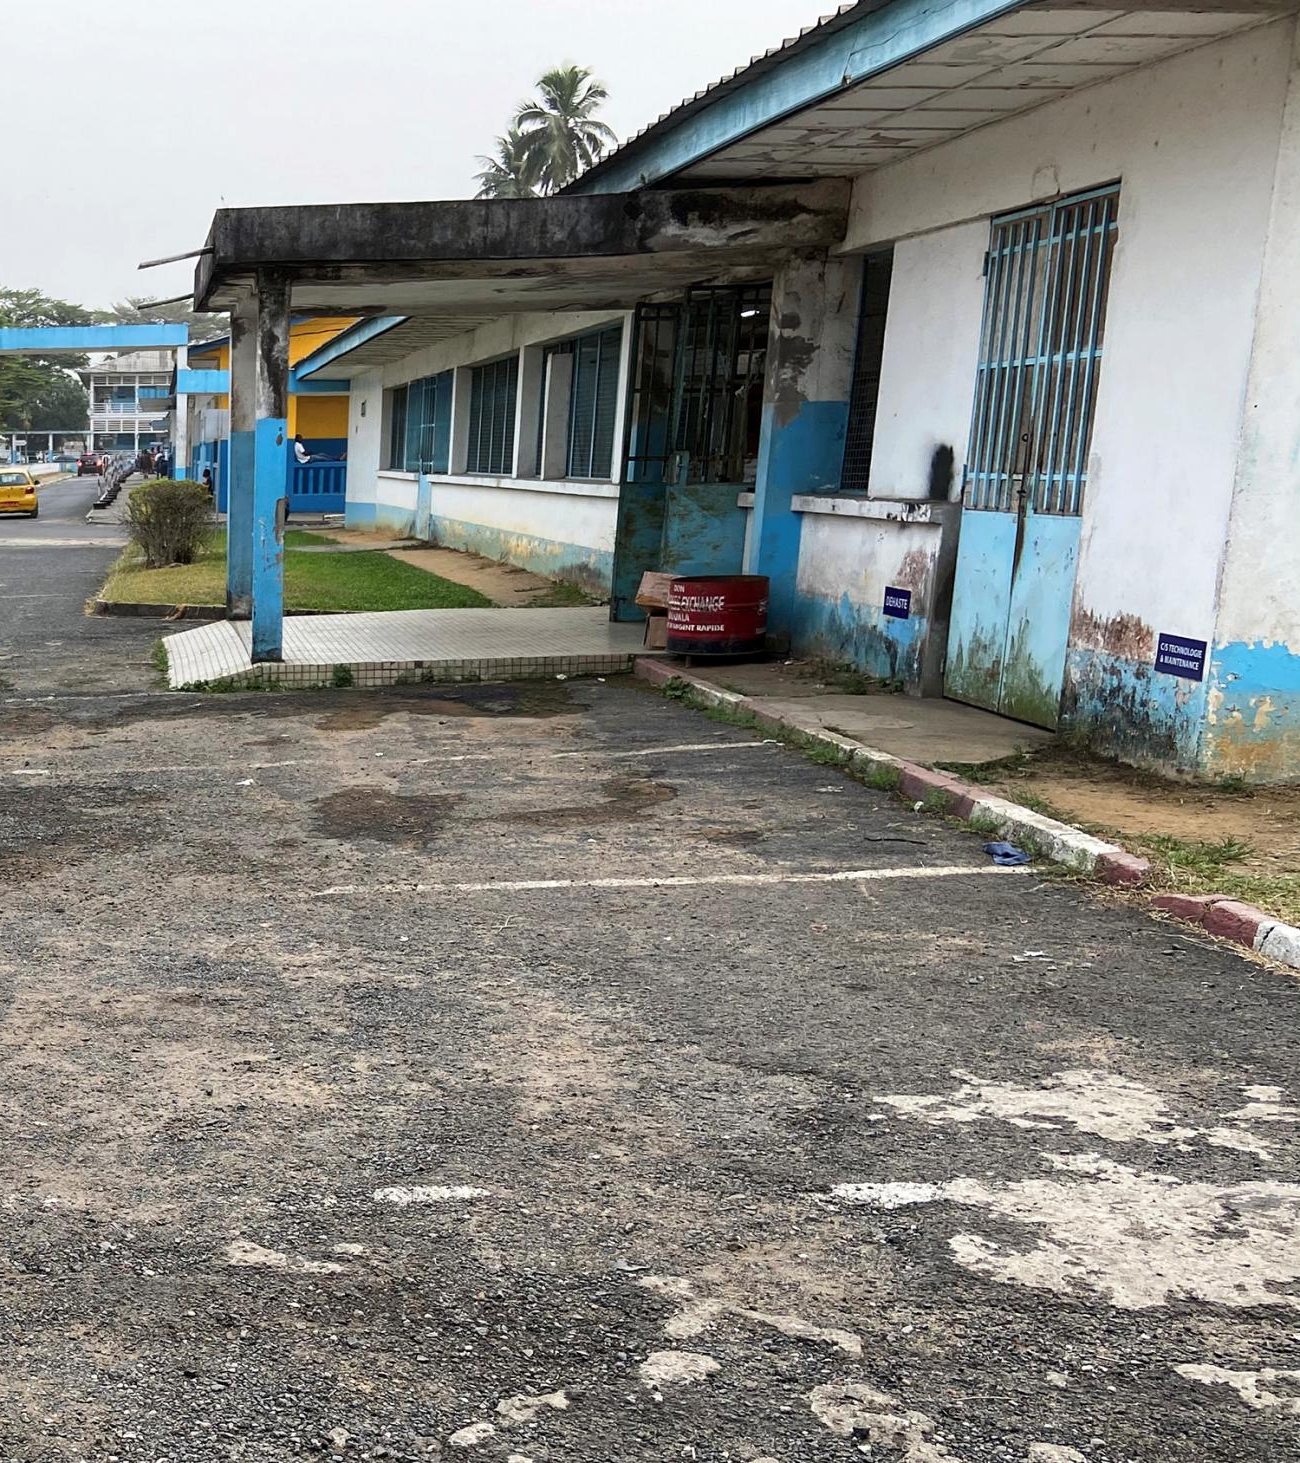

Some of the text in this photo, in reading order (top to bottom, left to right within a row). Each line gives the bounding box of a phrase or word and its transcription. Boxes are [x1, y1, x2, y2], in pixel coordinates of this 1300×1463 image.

[681, 596, 725, 612] EXCHANGE
[696, 624, 725, 632] RAPIDE
[1169, 644, 1203, 659] TECHNOLOGIE
[1164, 655, 1199, 670] MAINTENANCE
